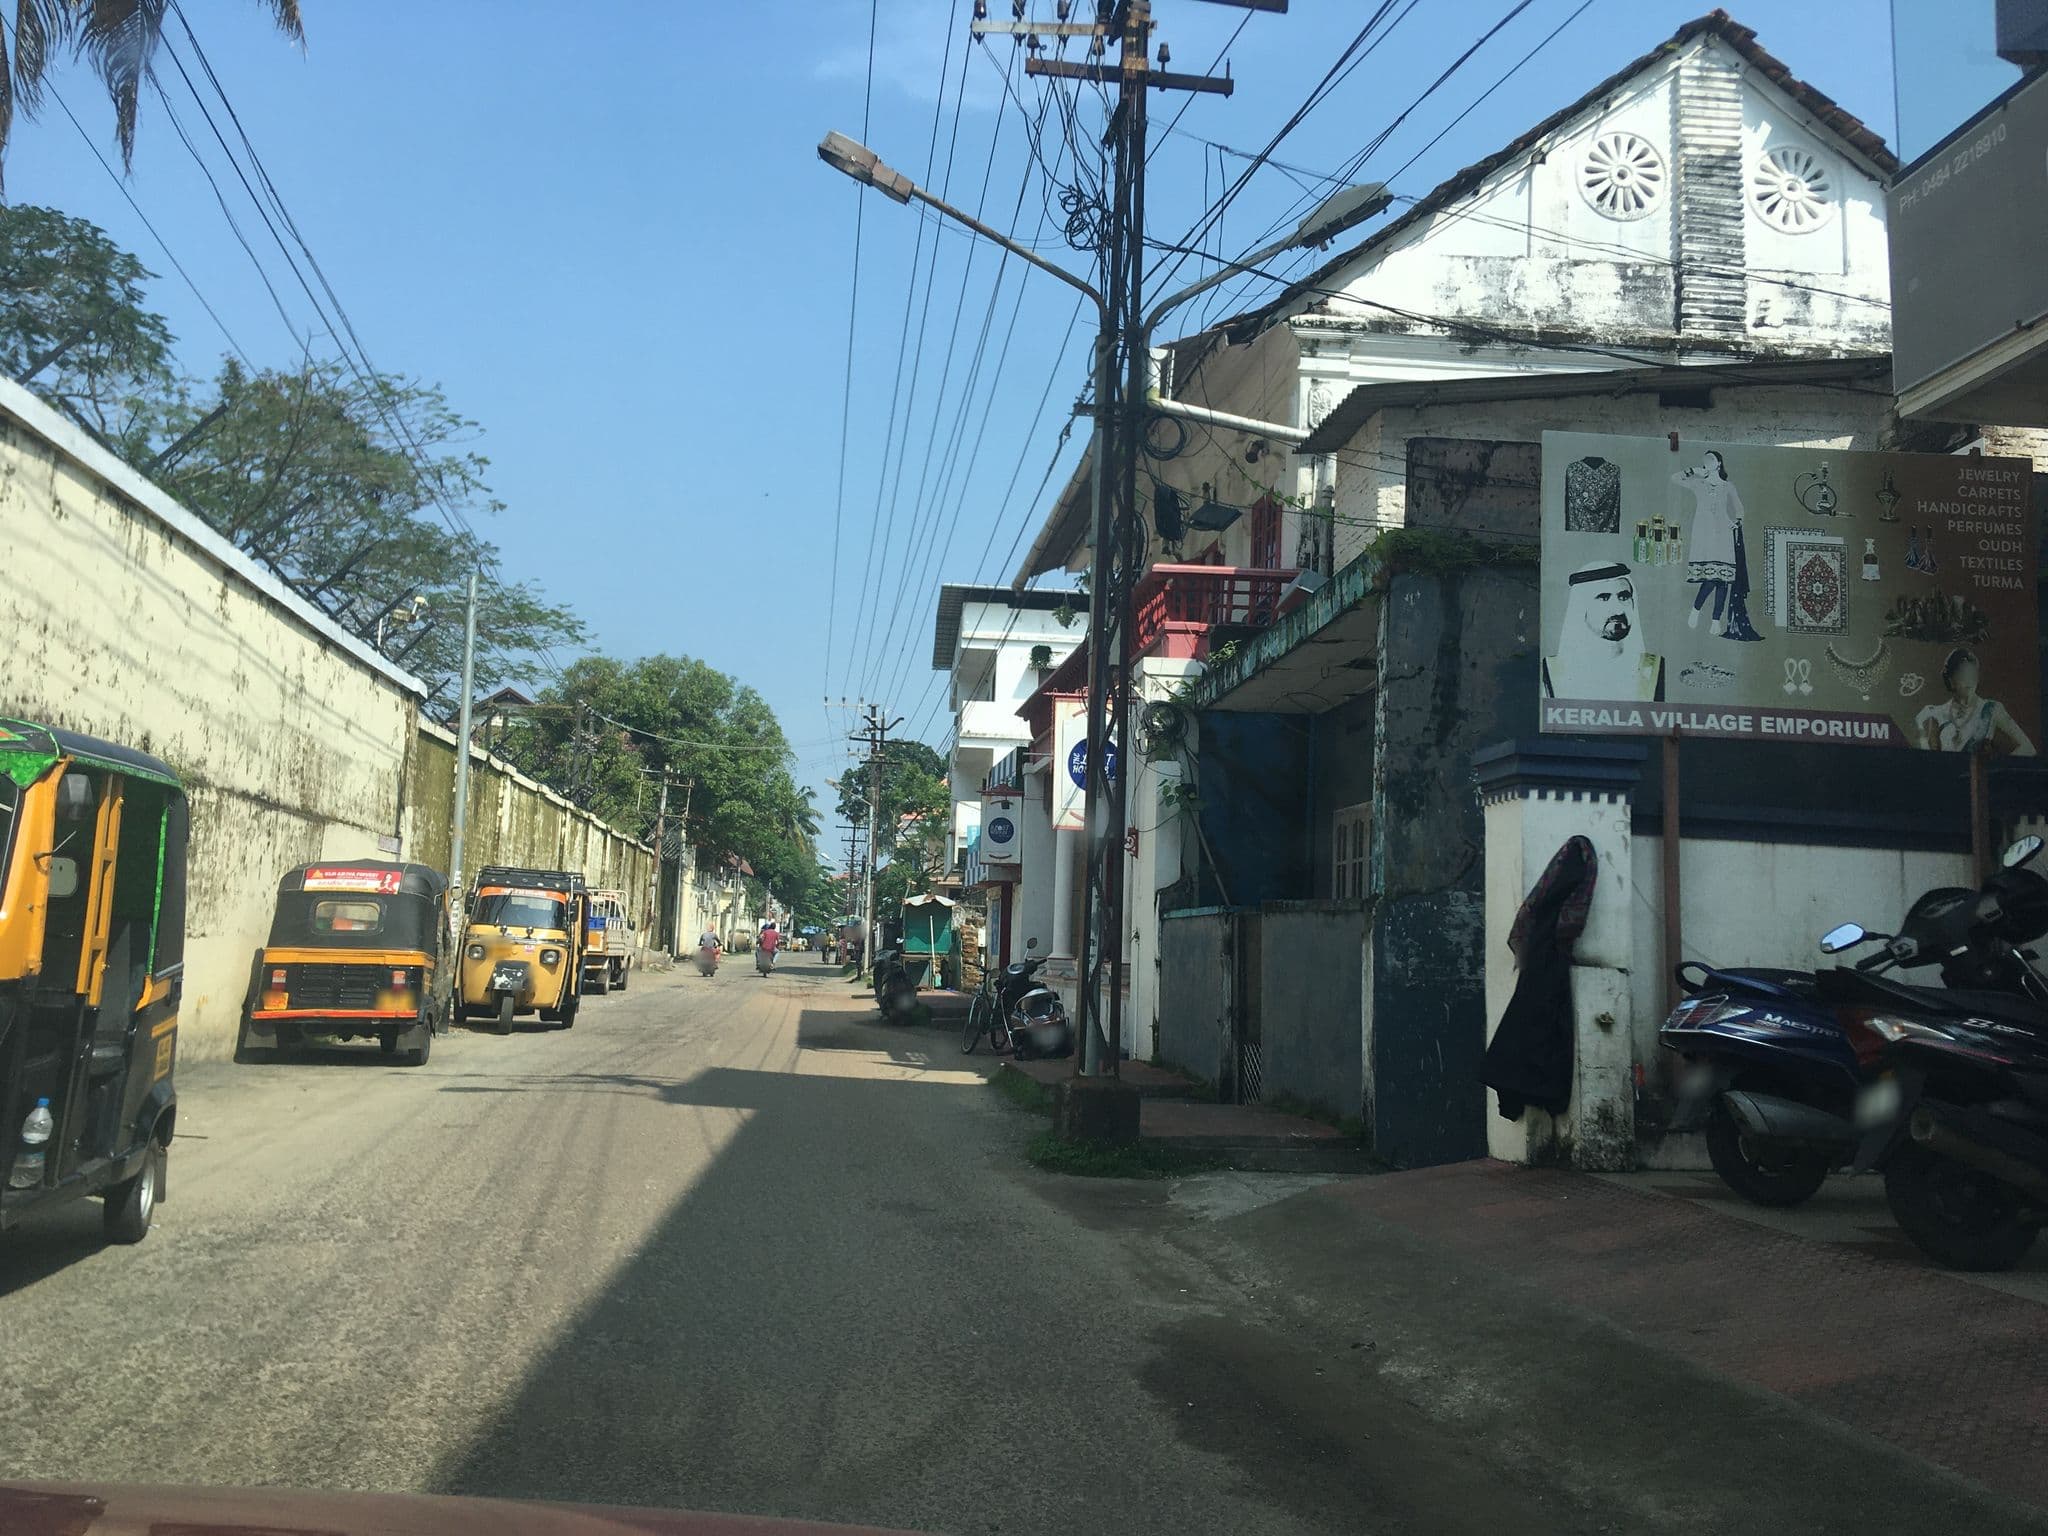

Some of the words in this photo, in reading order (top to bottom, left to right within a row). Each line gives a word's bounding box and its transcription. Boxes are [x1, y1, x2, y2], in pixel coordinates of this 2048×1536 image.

[1958, 468, 2020, 483] JEWELRY
[1958, 485, 2021, 500] CARPETS
[1917, 501, 2022, 518] HANDICRAFTS
[1948, 520, 2022, 535] PERFUMES
[1979, 540, 2022, 553] OUDH
[1959, 555, 2023, 571] TEXTILES
[1973, 574, 2024, 590] TURMA
[1547, 707, 1643, 727] KERALA
[1650, 711, 1753, 733] VILLAGE
[1761, 716, 1890, 739] EMPORIUM
